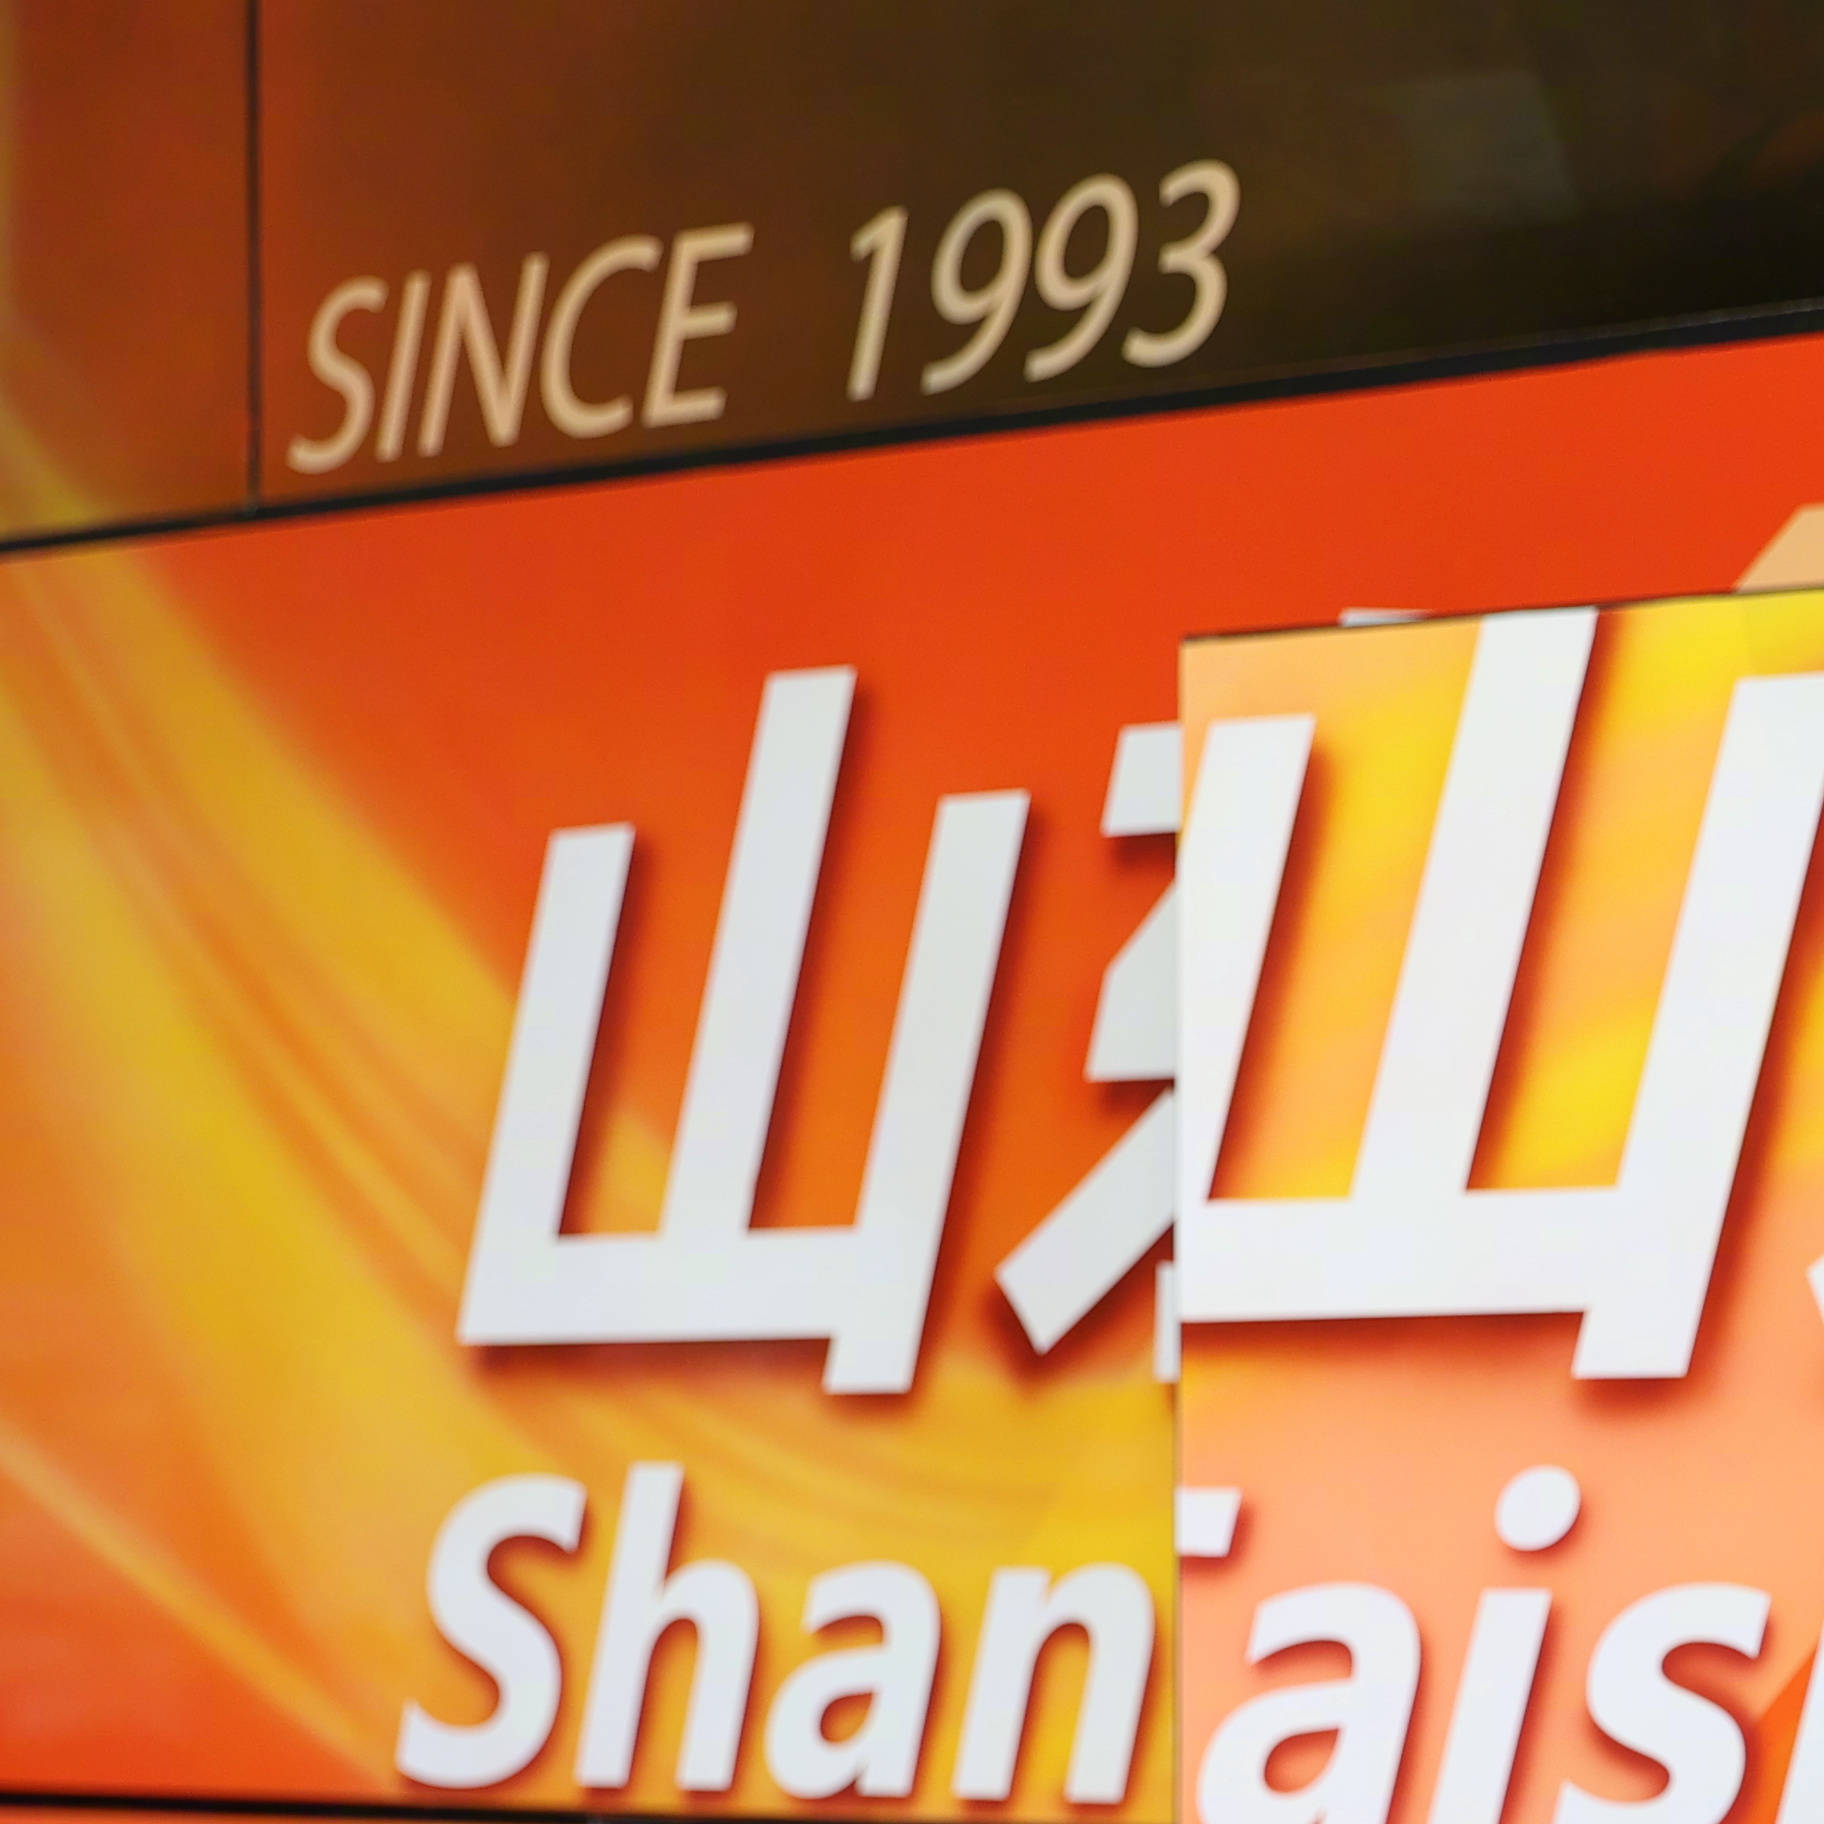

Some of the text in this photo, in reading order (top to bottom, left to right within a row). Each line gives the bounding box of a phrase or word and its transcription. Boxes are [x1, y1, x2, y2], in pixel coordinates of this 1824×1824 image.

[288, 160, 1240, 474] SINCE 1993
[400, 1465, 1153, 1801] Shan
